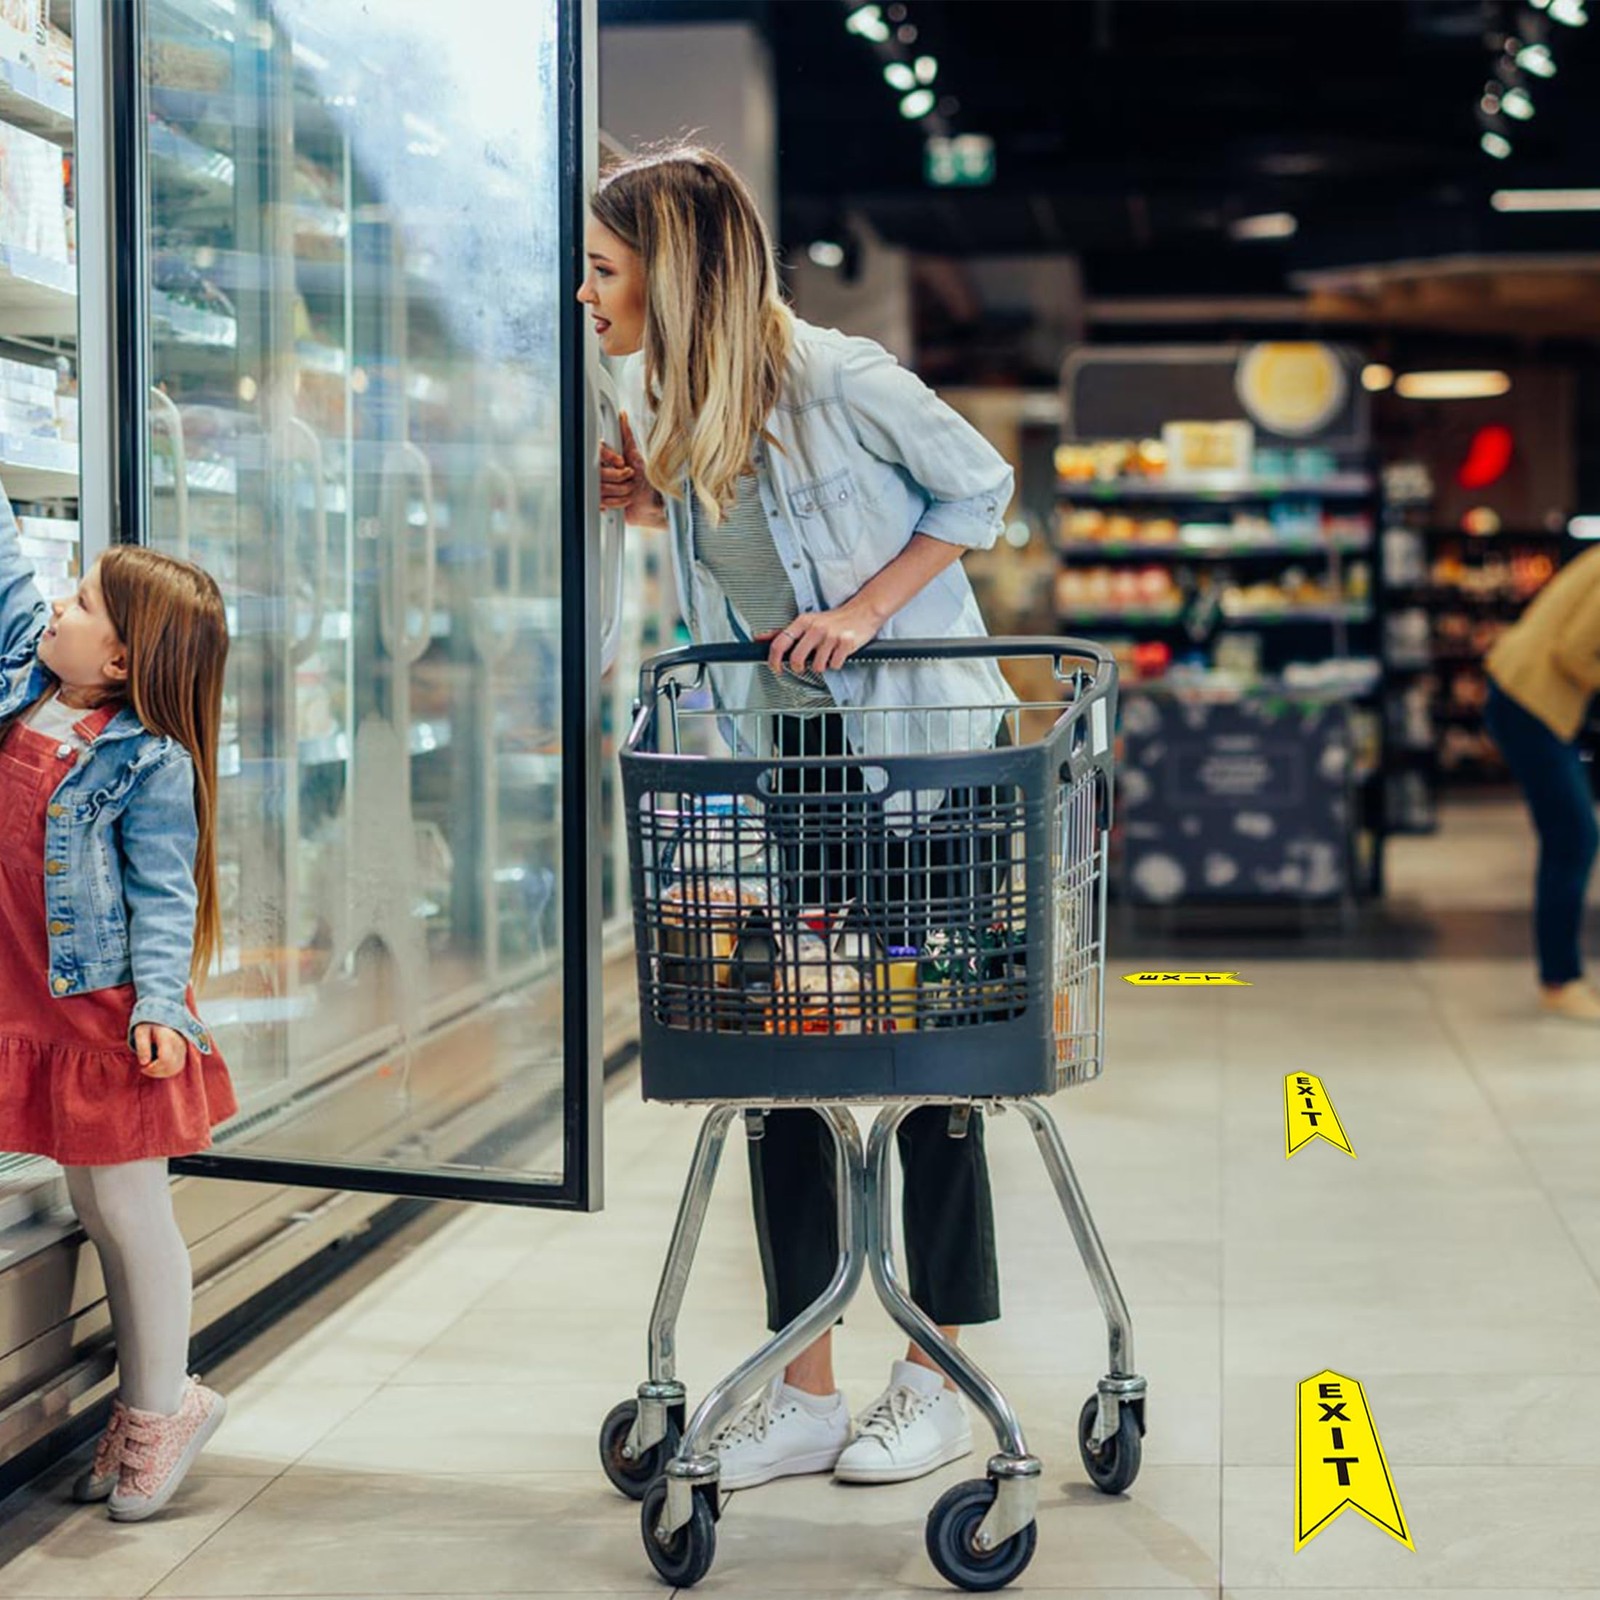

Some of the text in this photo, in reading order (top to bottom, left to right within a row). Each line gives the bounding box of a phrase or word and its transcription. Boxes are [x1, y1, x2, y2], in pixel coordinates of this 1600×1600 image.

[1138, 974, 1222, 982] EXIT
[1296, 1076, 1322, 1127] EXIT
[1318, 1383, 1360, 1486] EXIT
